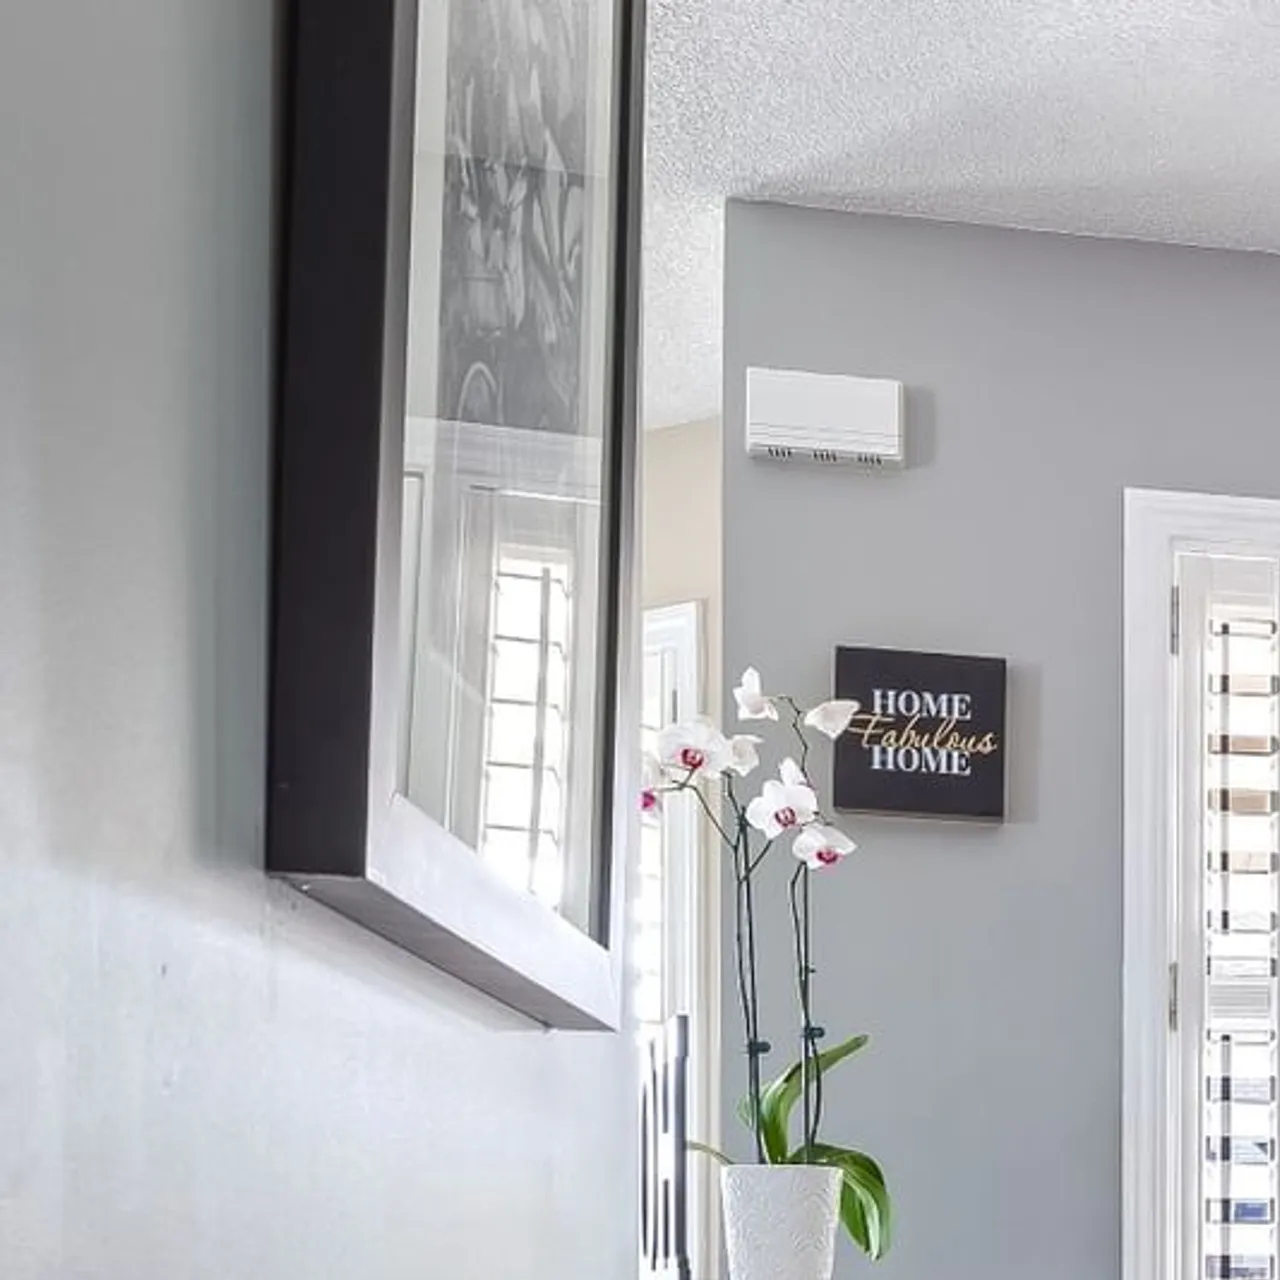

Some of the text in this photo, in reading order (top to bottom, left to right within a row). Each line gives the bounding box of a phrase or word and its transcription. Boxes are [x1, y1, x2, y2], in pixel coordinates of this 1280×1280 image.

[871, 688, 972, 720] HOME
[848, 713, 997, 754] Fabulous
[870, 744, 972, 776] HOME
